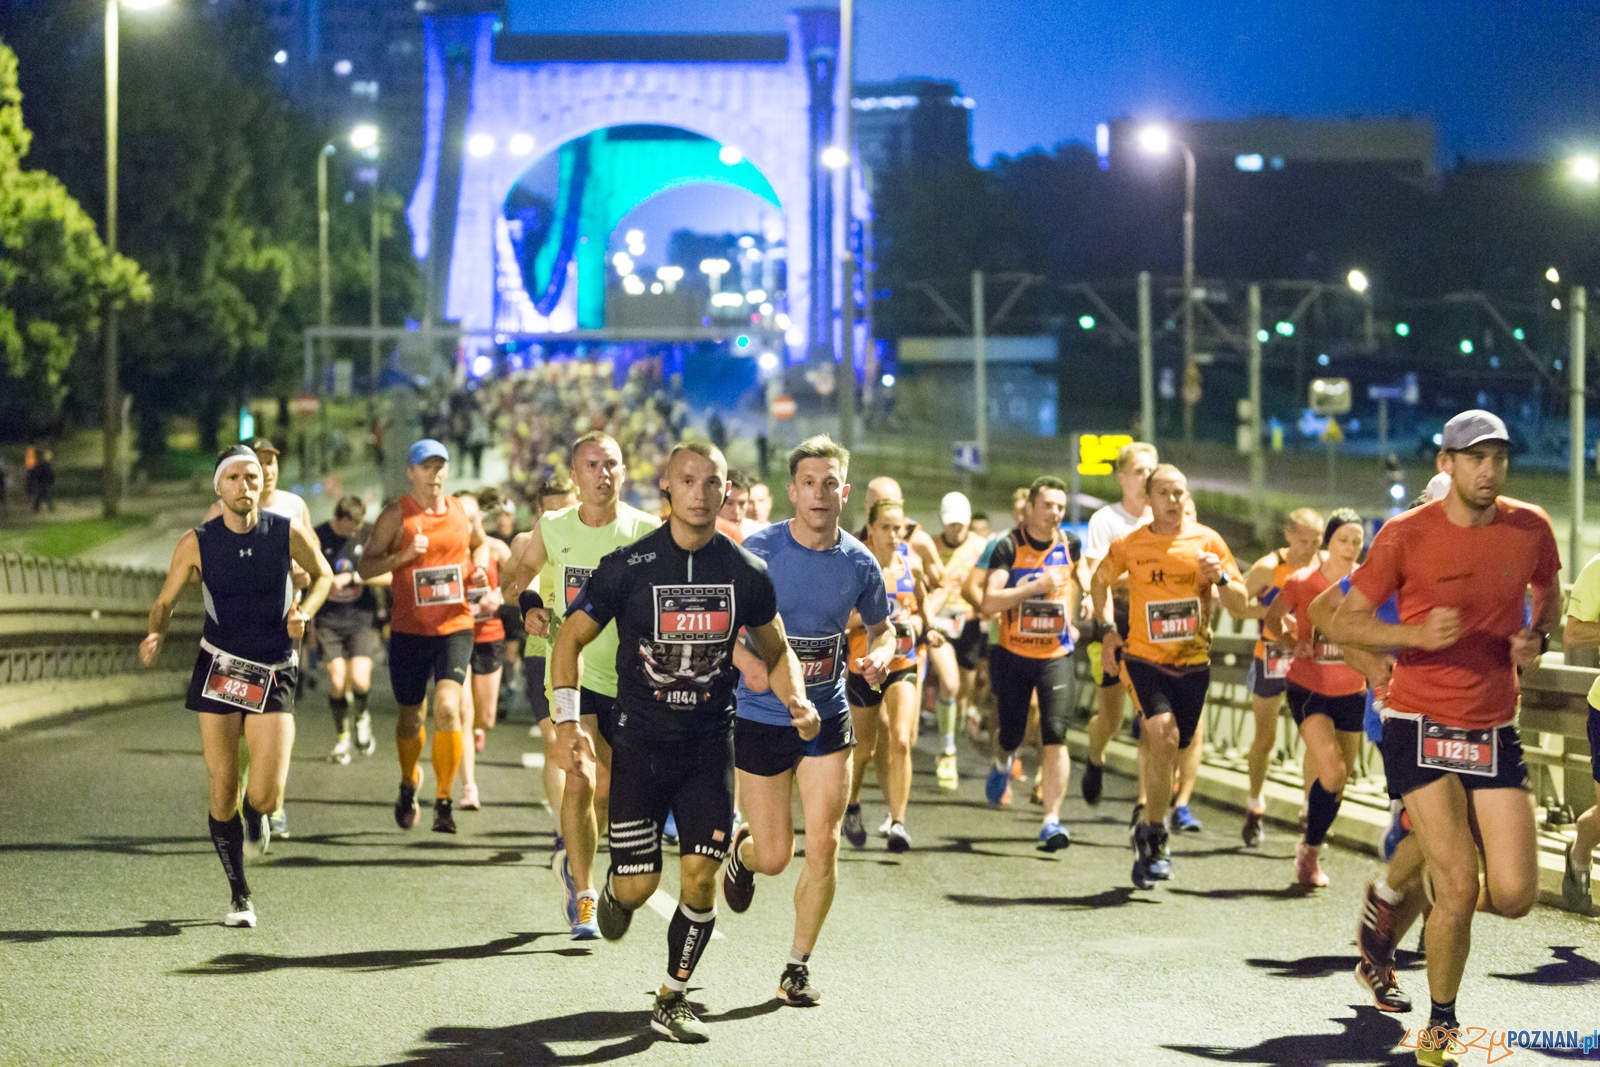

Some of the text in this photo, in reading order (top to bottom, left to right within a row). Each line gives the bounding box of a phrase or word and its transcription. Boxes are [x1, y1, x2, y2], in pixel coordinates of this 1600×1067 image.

[676, 613, 711, 631] 2711
[224, 679, 249, 697] 423
[1436, 740, 1480, 762] 11215
